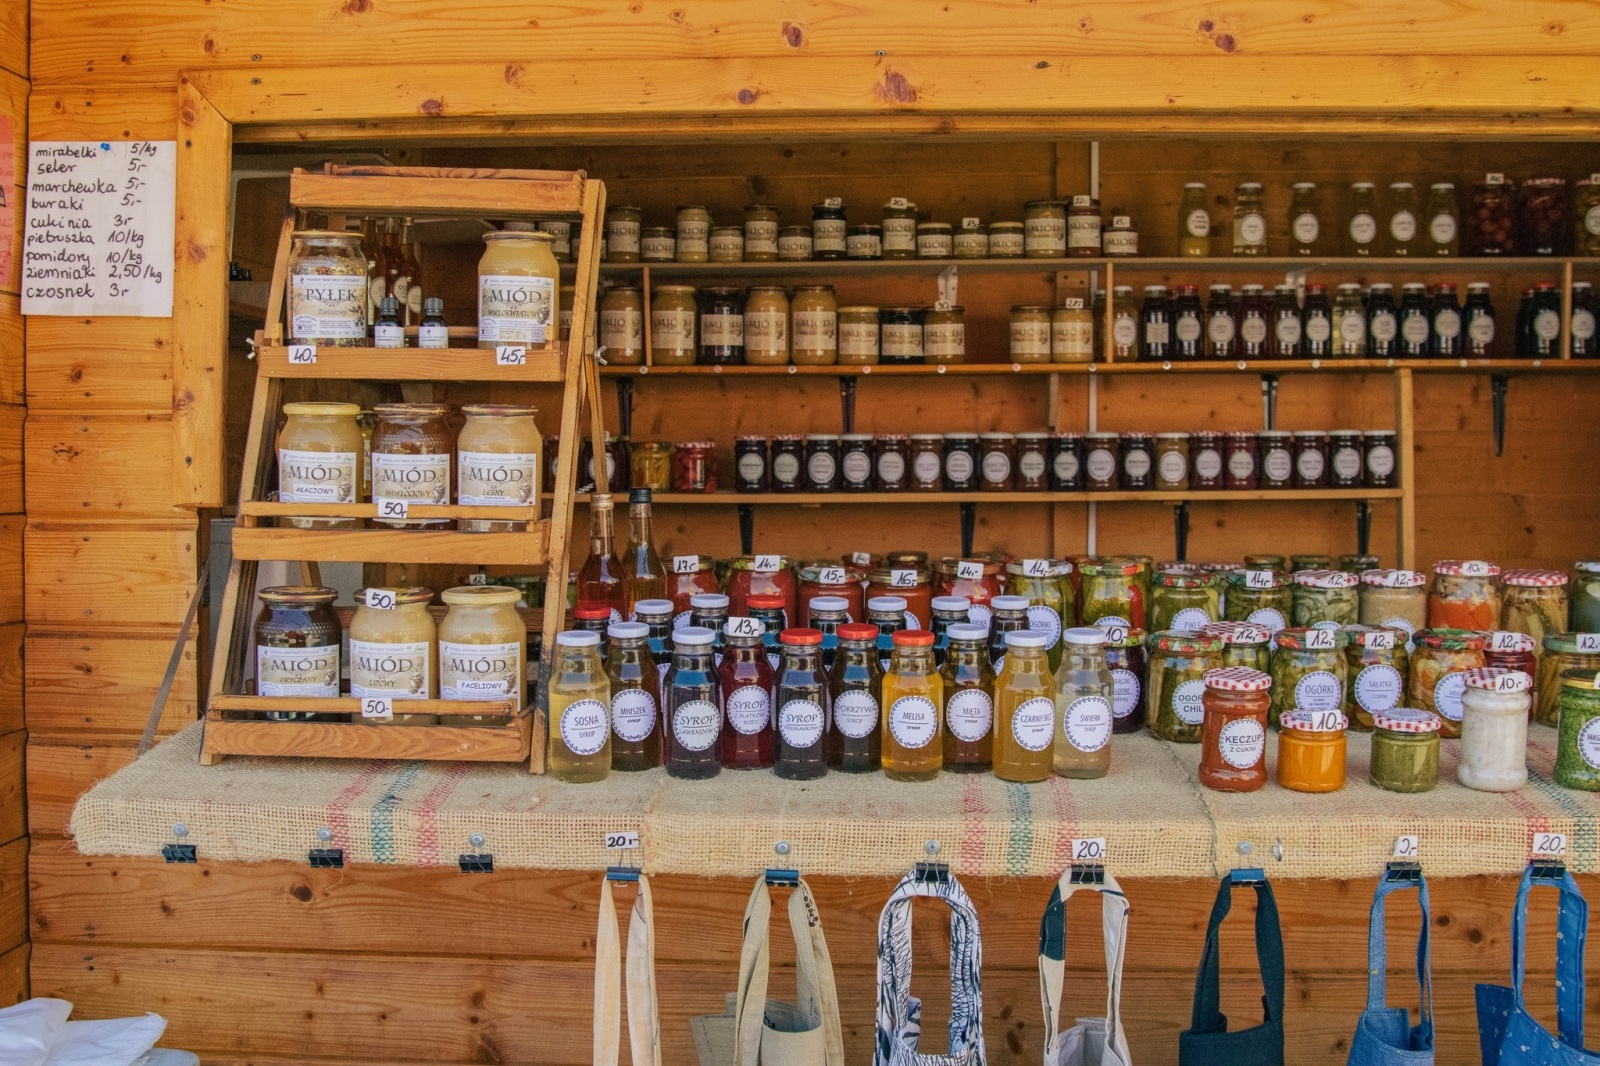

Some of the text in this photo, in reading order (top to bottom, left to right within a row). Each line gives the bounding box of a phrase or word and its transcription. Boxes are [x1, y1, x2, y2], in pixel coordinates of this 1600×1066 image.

[36, 141, 158, 158] mirabelki 5/kg
[38, 159, 77, 174] seler
[32, 178, 117, 194] marchewka
[32, 196, 84, 211] buraki
[31, 214, 92, 229] cukinia
[28, 230, 144, 248] pietruszka 10/kg
[26, 248, 143, 268] pomidory 10/kg
[26, 264, 96, 280] ziemniaki
[26, 284, 95, 298] czosnek
[306, 288, 357, 300] PYŁEK
[490, 287, 542, 303] MIÓD
[288, 464, 342, 480] MIÓD
[382, 467, 436, 483] MIÓD
[469, 466, 523, 482] MIÓD
[270, 657, 328, 672] MIÓD
[358, 656, 413, 672] MIÓD
[450, 656, 506, 674] MIÓD
[369, 680, 397, 688] LIPOWY
[461, 682, 502, 690] FACELIOWY
[1304, 684, 1334, 694] OGÓRKI
[620, 707, 646, 716] MNISZEK
[733, 700, 766, 710] SYROP
[786, 714, 818, 723] SYROP
[903, 712, 924, 720] MELISA
[962, 708, 980, 717] MIĘTA
[1020, 714, 1042, 723] CZARNY
[1080, 714, 1100, 722] ŚWIERK
[574, 716, 599, 726] SOSNA
[680, 714, 716, 726] SYROP
[1225, 734, 1262, 744] KECZUP
